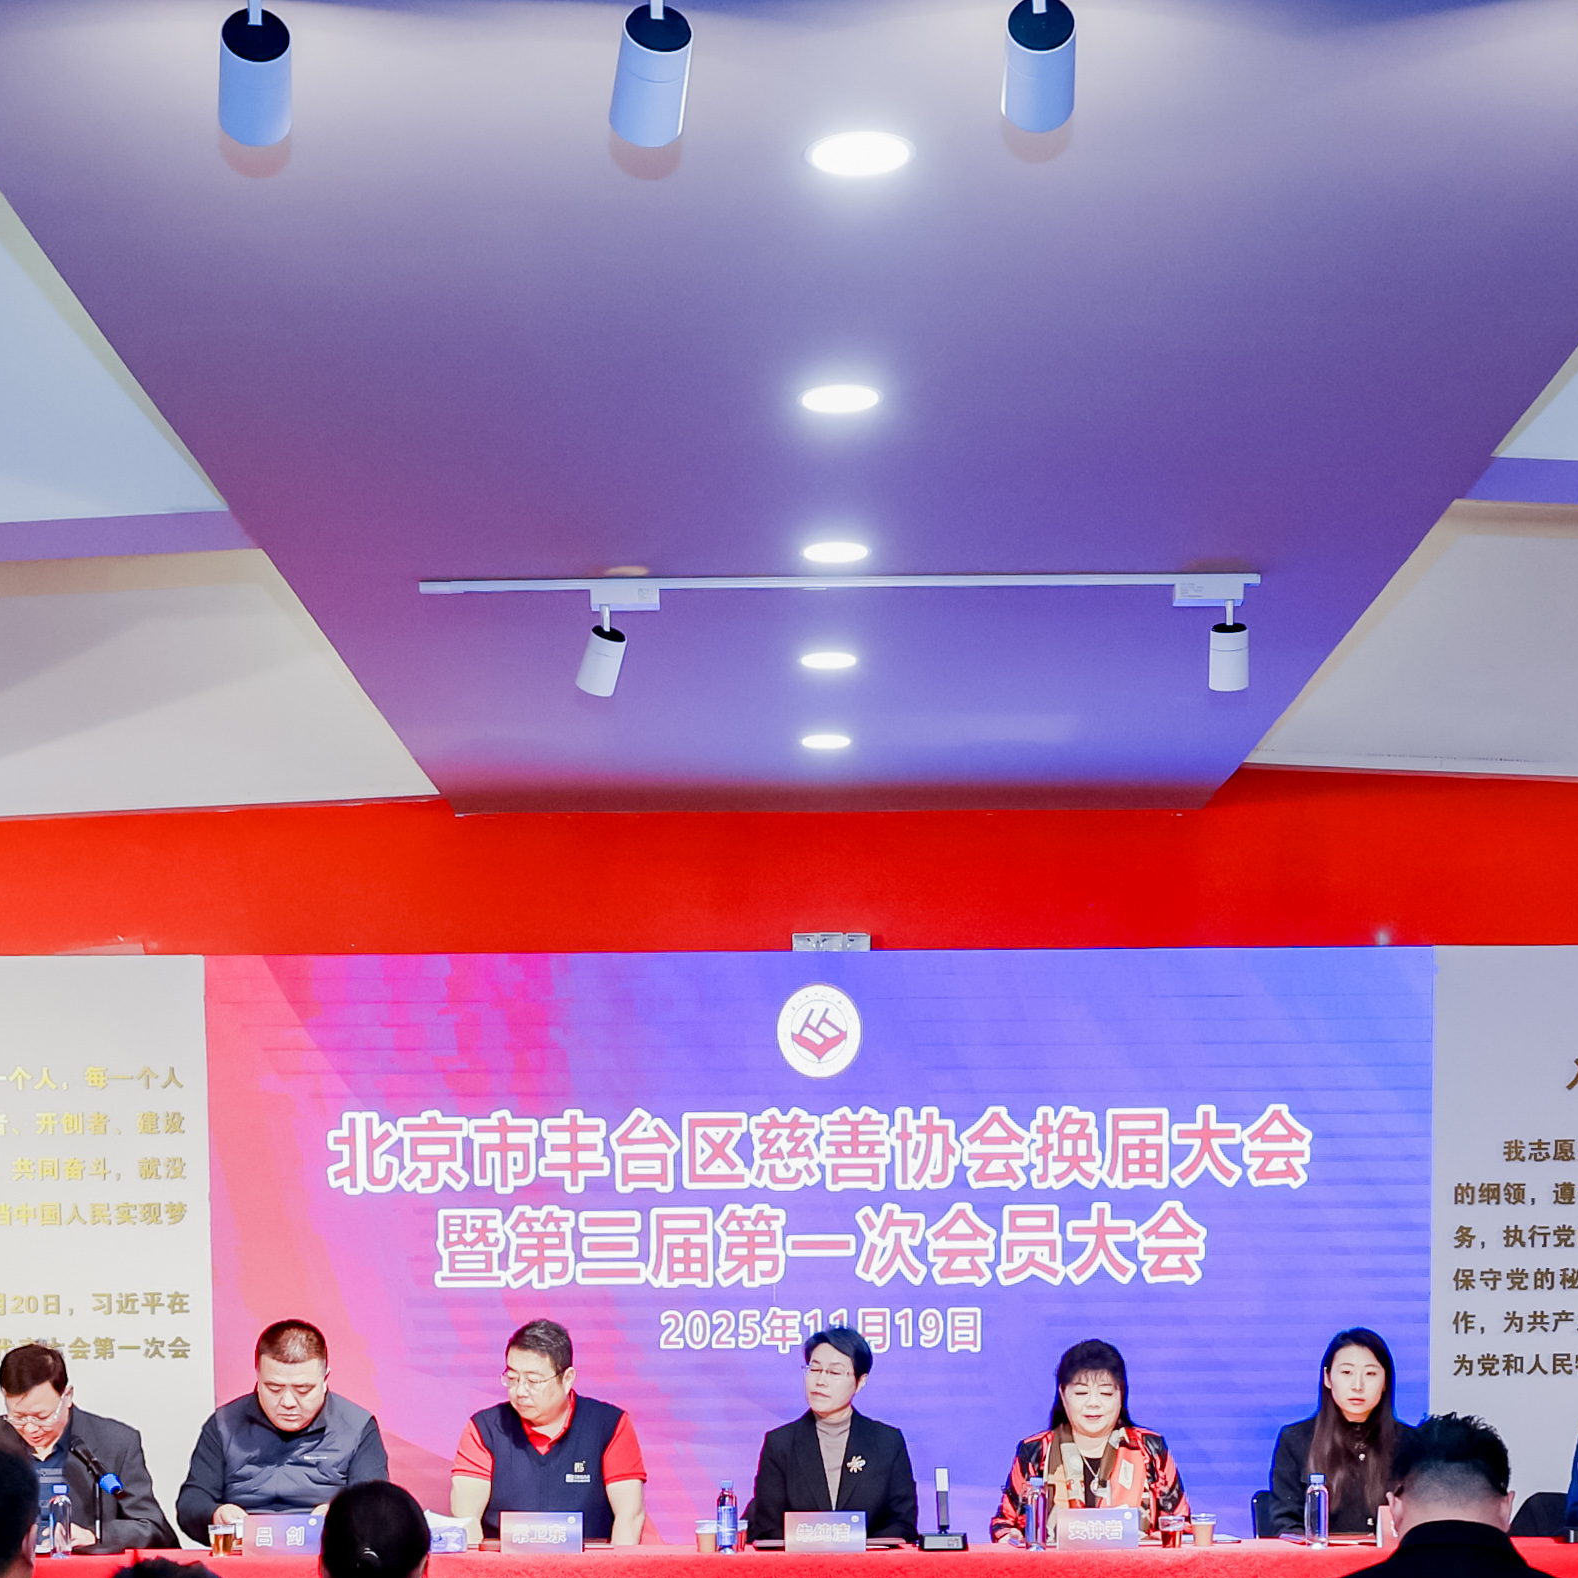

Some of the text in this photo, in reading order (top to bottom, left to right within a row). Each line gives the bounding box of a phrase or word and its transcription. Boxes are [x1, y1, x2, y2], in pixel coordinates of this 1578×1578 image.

[326, 1103, 1311, 1197] 北京市丰台区慈善协会换届大会
[435, 1200, 1207, 1291] 暨第三届第一次会员大会
[511, 1523, 568, 1544] 常卫东
